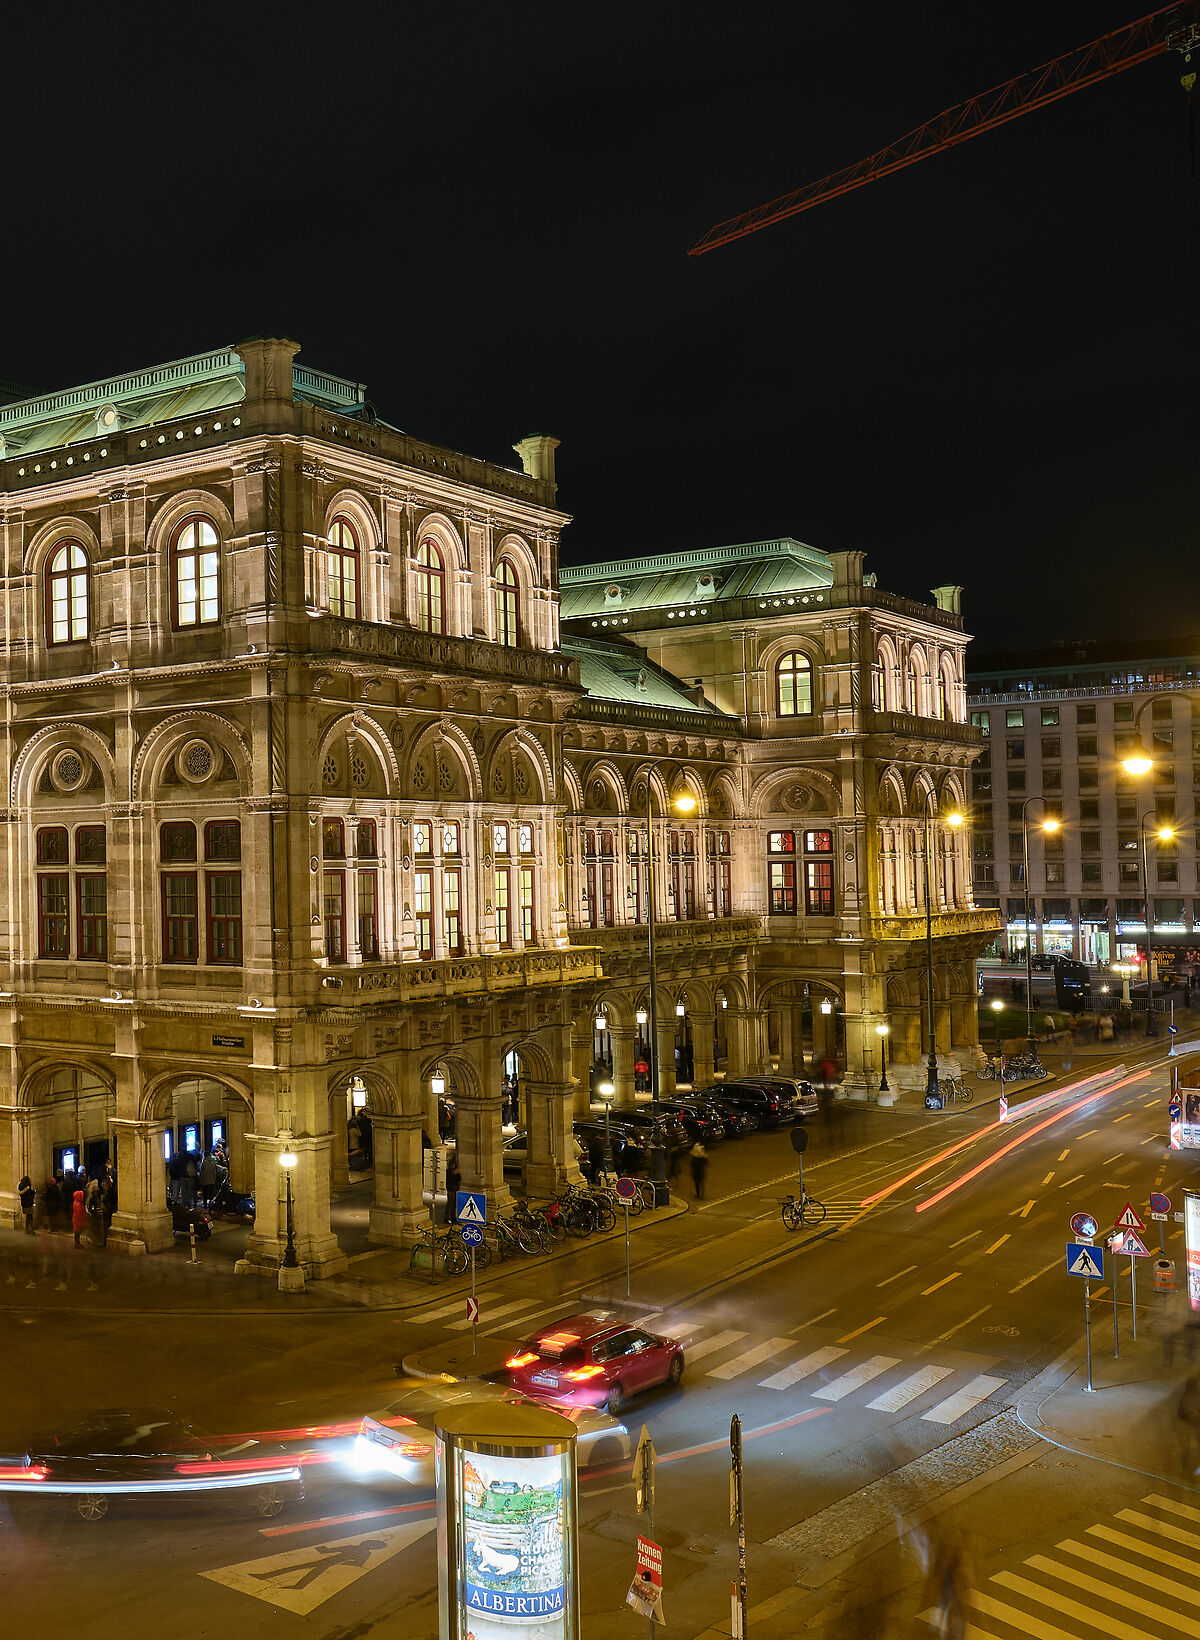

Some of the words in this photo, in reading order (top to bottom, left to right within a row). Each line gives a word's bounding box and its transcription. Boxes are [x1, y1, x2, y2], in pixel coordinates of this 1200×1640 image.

[520, 1540, 562, 1555] MUNCH
[637, 1538, 662, 1561] Kronen
[637, 1552, 662, 1575] Zeitung
[471, 1591, 562, 1613] ALBERTINA
